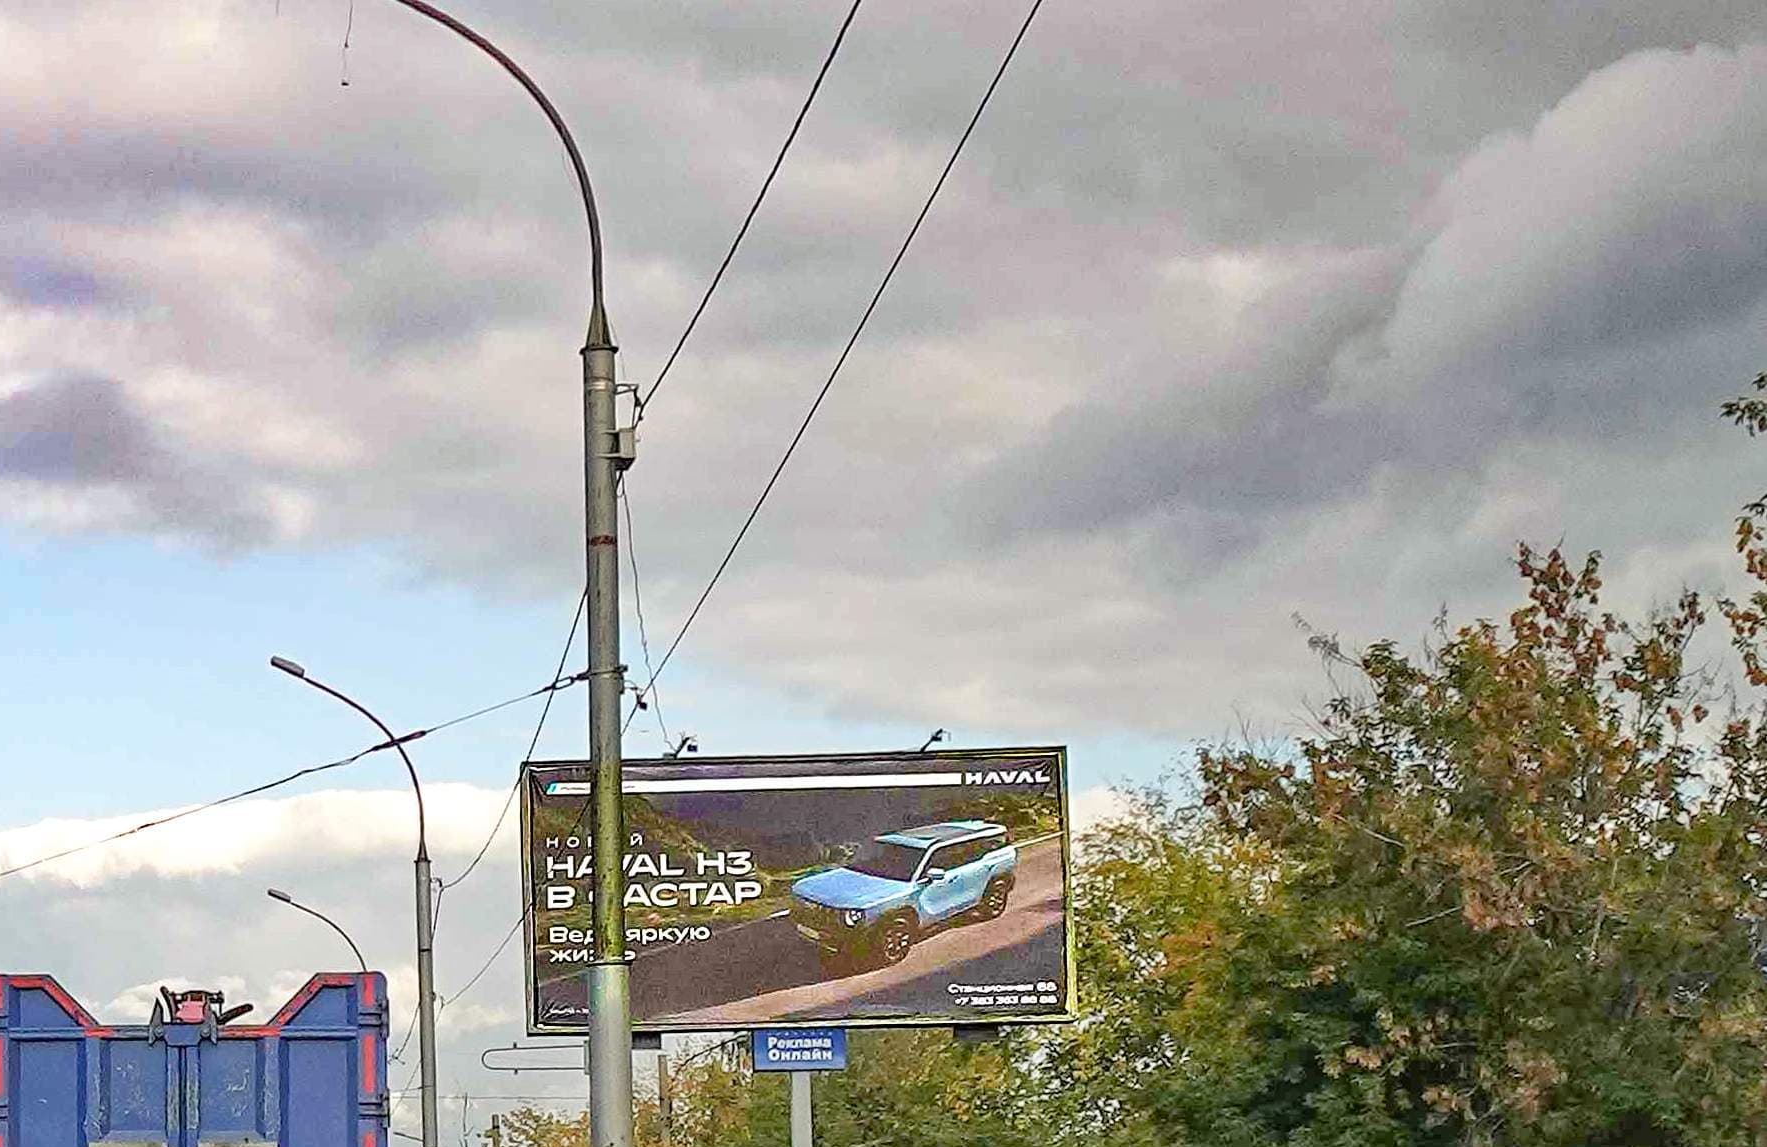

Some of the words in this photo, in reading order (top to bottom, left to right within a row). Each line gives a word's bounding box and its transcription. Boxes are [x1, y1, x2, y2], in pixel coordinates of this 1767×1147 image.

[965, 770, 1051, 785] HAVAL
[546, 832, 643, 848] НОЙ
[588, 881, 762, 907] АСТАР
[626, 926, 711, 945] яркую
[767, 1036, 832, 1049] Реклама
[767, 1048, 833, 1061] Онлайн
